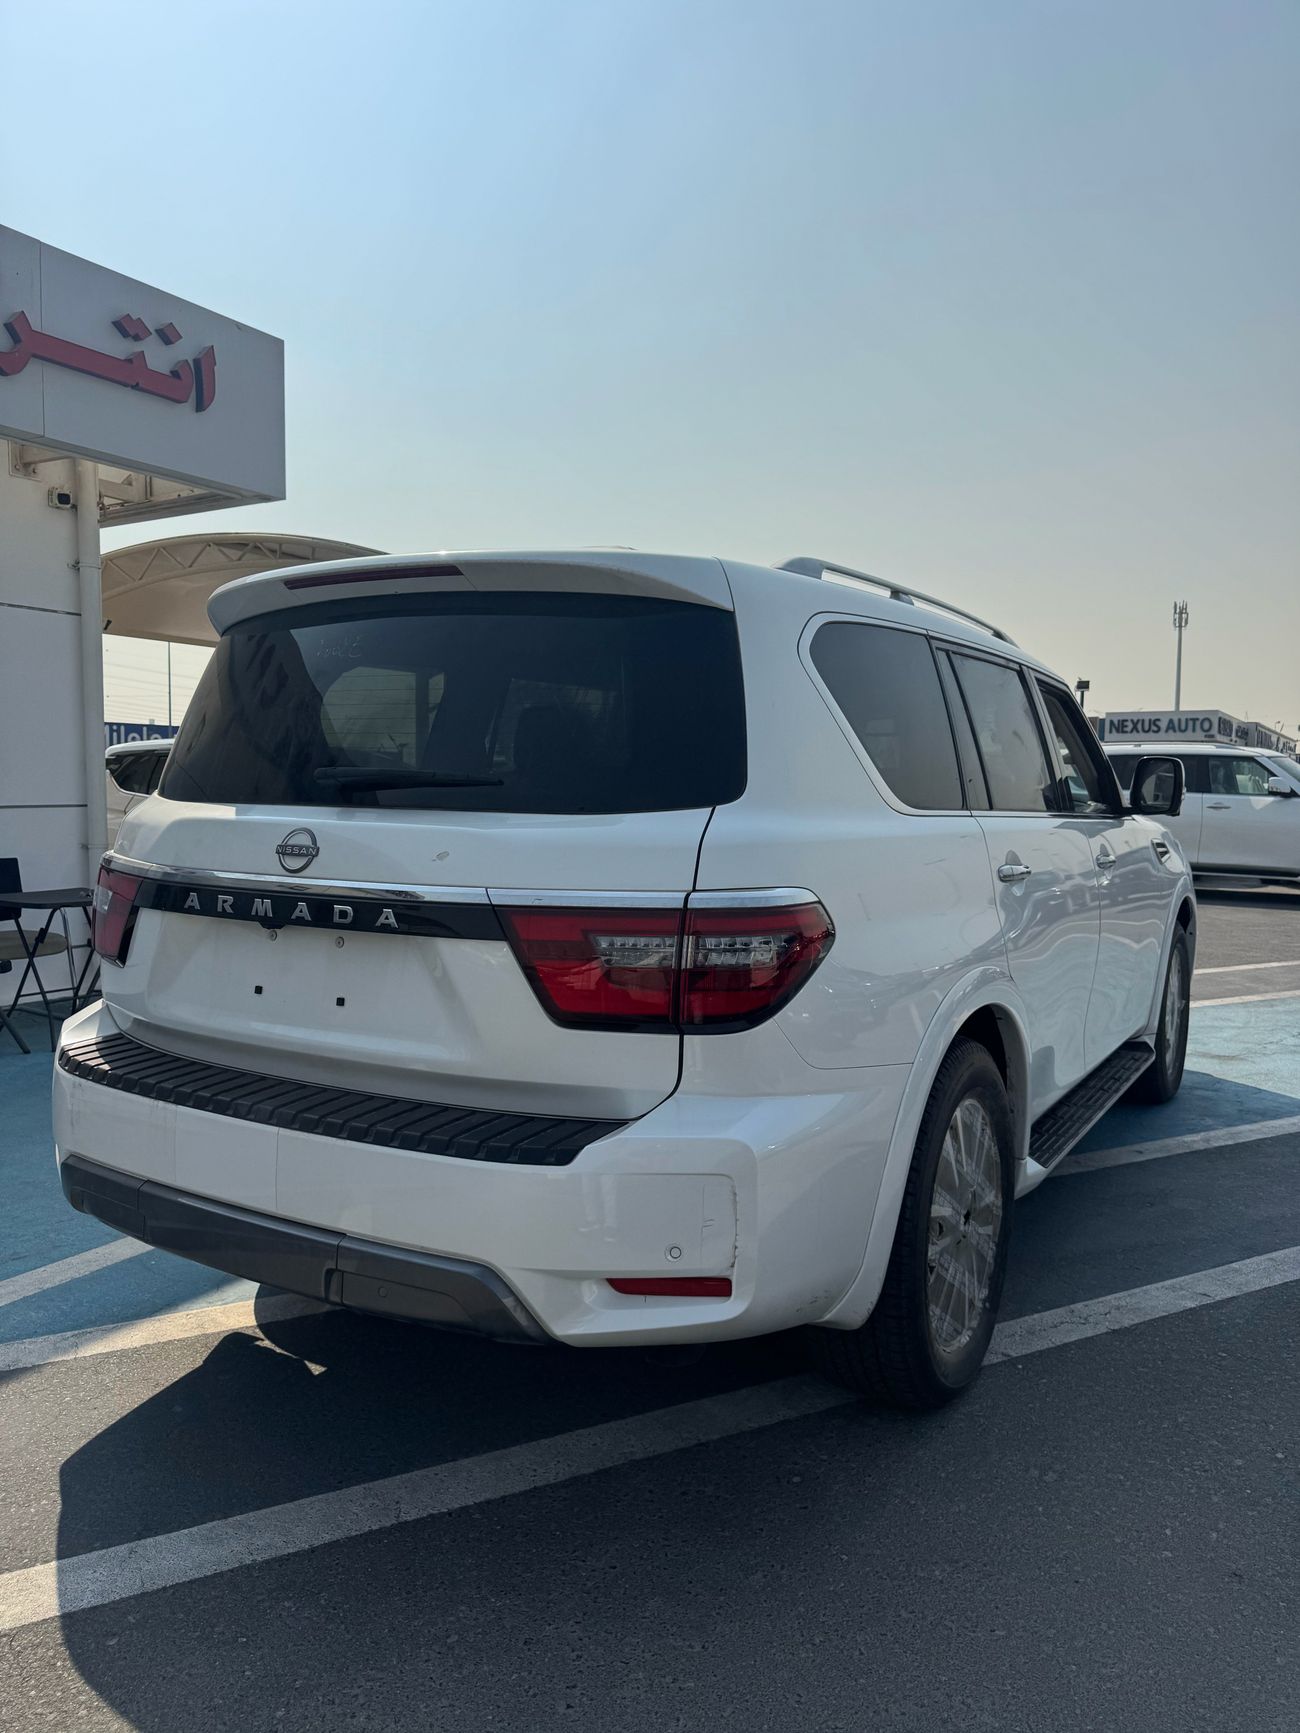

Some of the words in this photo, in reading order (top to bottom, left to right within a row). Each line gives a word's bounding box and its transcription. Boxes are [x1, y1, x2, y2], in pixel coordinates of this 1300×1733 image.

[1109, 717, 1161, 734] NEXUS
[1165, 717, 1213, 734] AUTO
[276, 845, 318, 856] NISSAN
[183, 892, 399, 929] ARMADA
